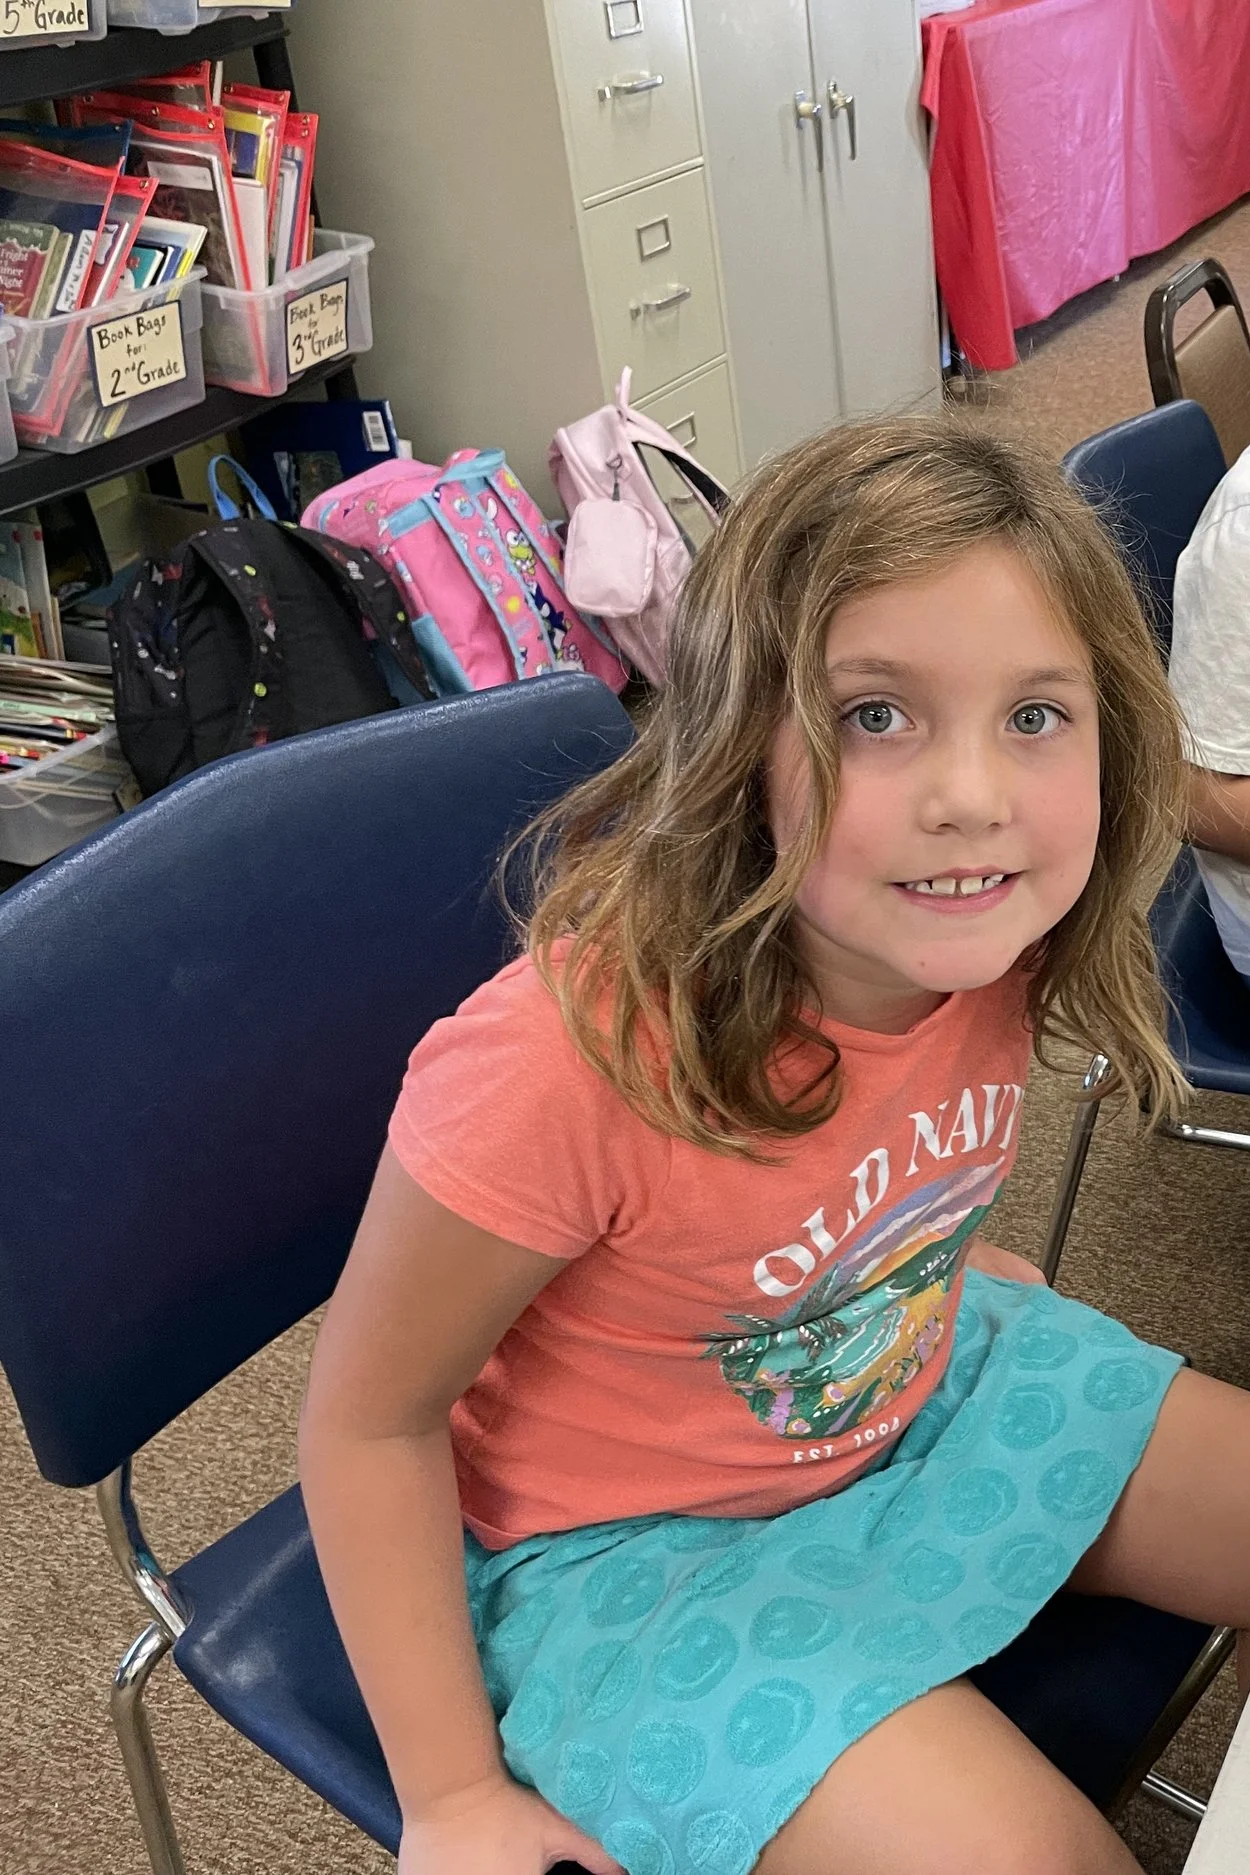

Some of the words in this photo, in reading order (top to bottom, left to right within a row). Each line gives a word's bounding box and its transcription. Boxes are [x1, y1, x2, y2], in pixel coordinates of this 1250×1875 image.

[35, 0, 84, 30] Grade
[290, 302, 316, 325] Book
[320, 293, 344, 316] Bags
[97, 324, 133, 349] Book
[136, 315, 166, 337] Bags
[311, 326, 344, 357] Grade
[110, 362, 136, 398] 2nd
[137, 359, 180, 385] Grade
[752, 1147, 890, 1297] OLD
